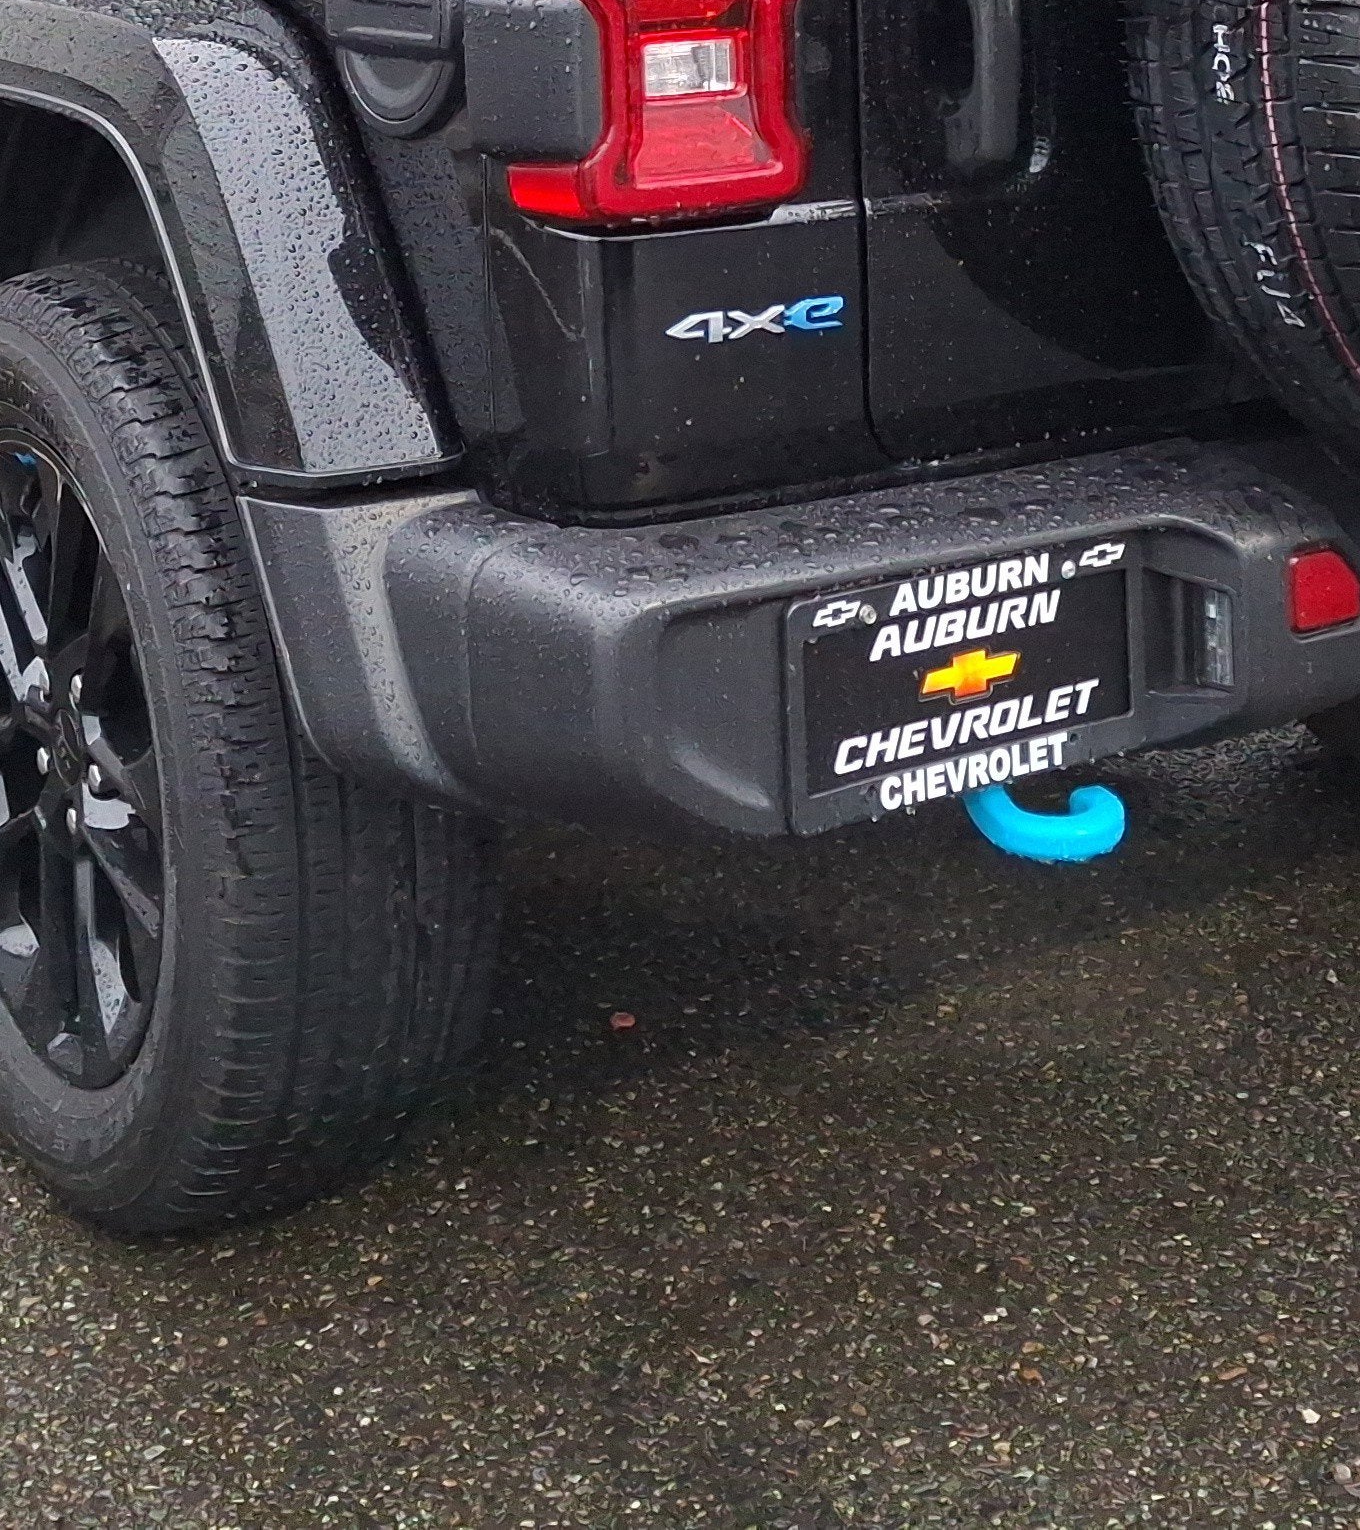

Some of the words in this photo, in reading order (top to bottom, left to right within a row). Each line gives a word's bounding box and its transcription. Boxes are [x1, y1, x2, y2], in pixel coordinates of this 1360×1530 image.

[889, 552, 1049, 617] AUBURN
[869, 588, 1061, 662] AUBURN
[834, 678, 1100, 775] CHEVROLET
[879, 732, 1068, 810] CHEVROLET
